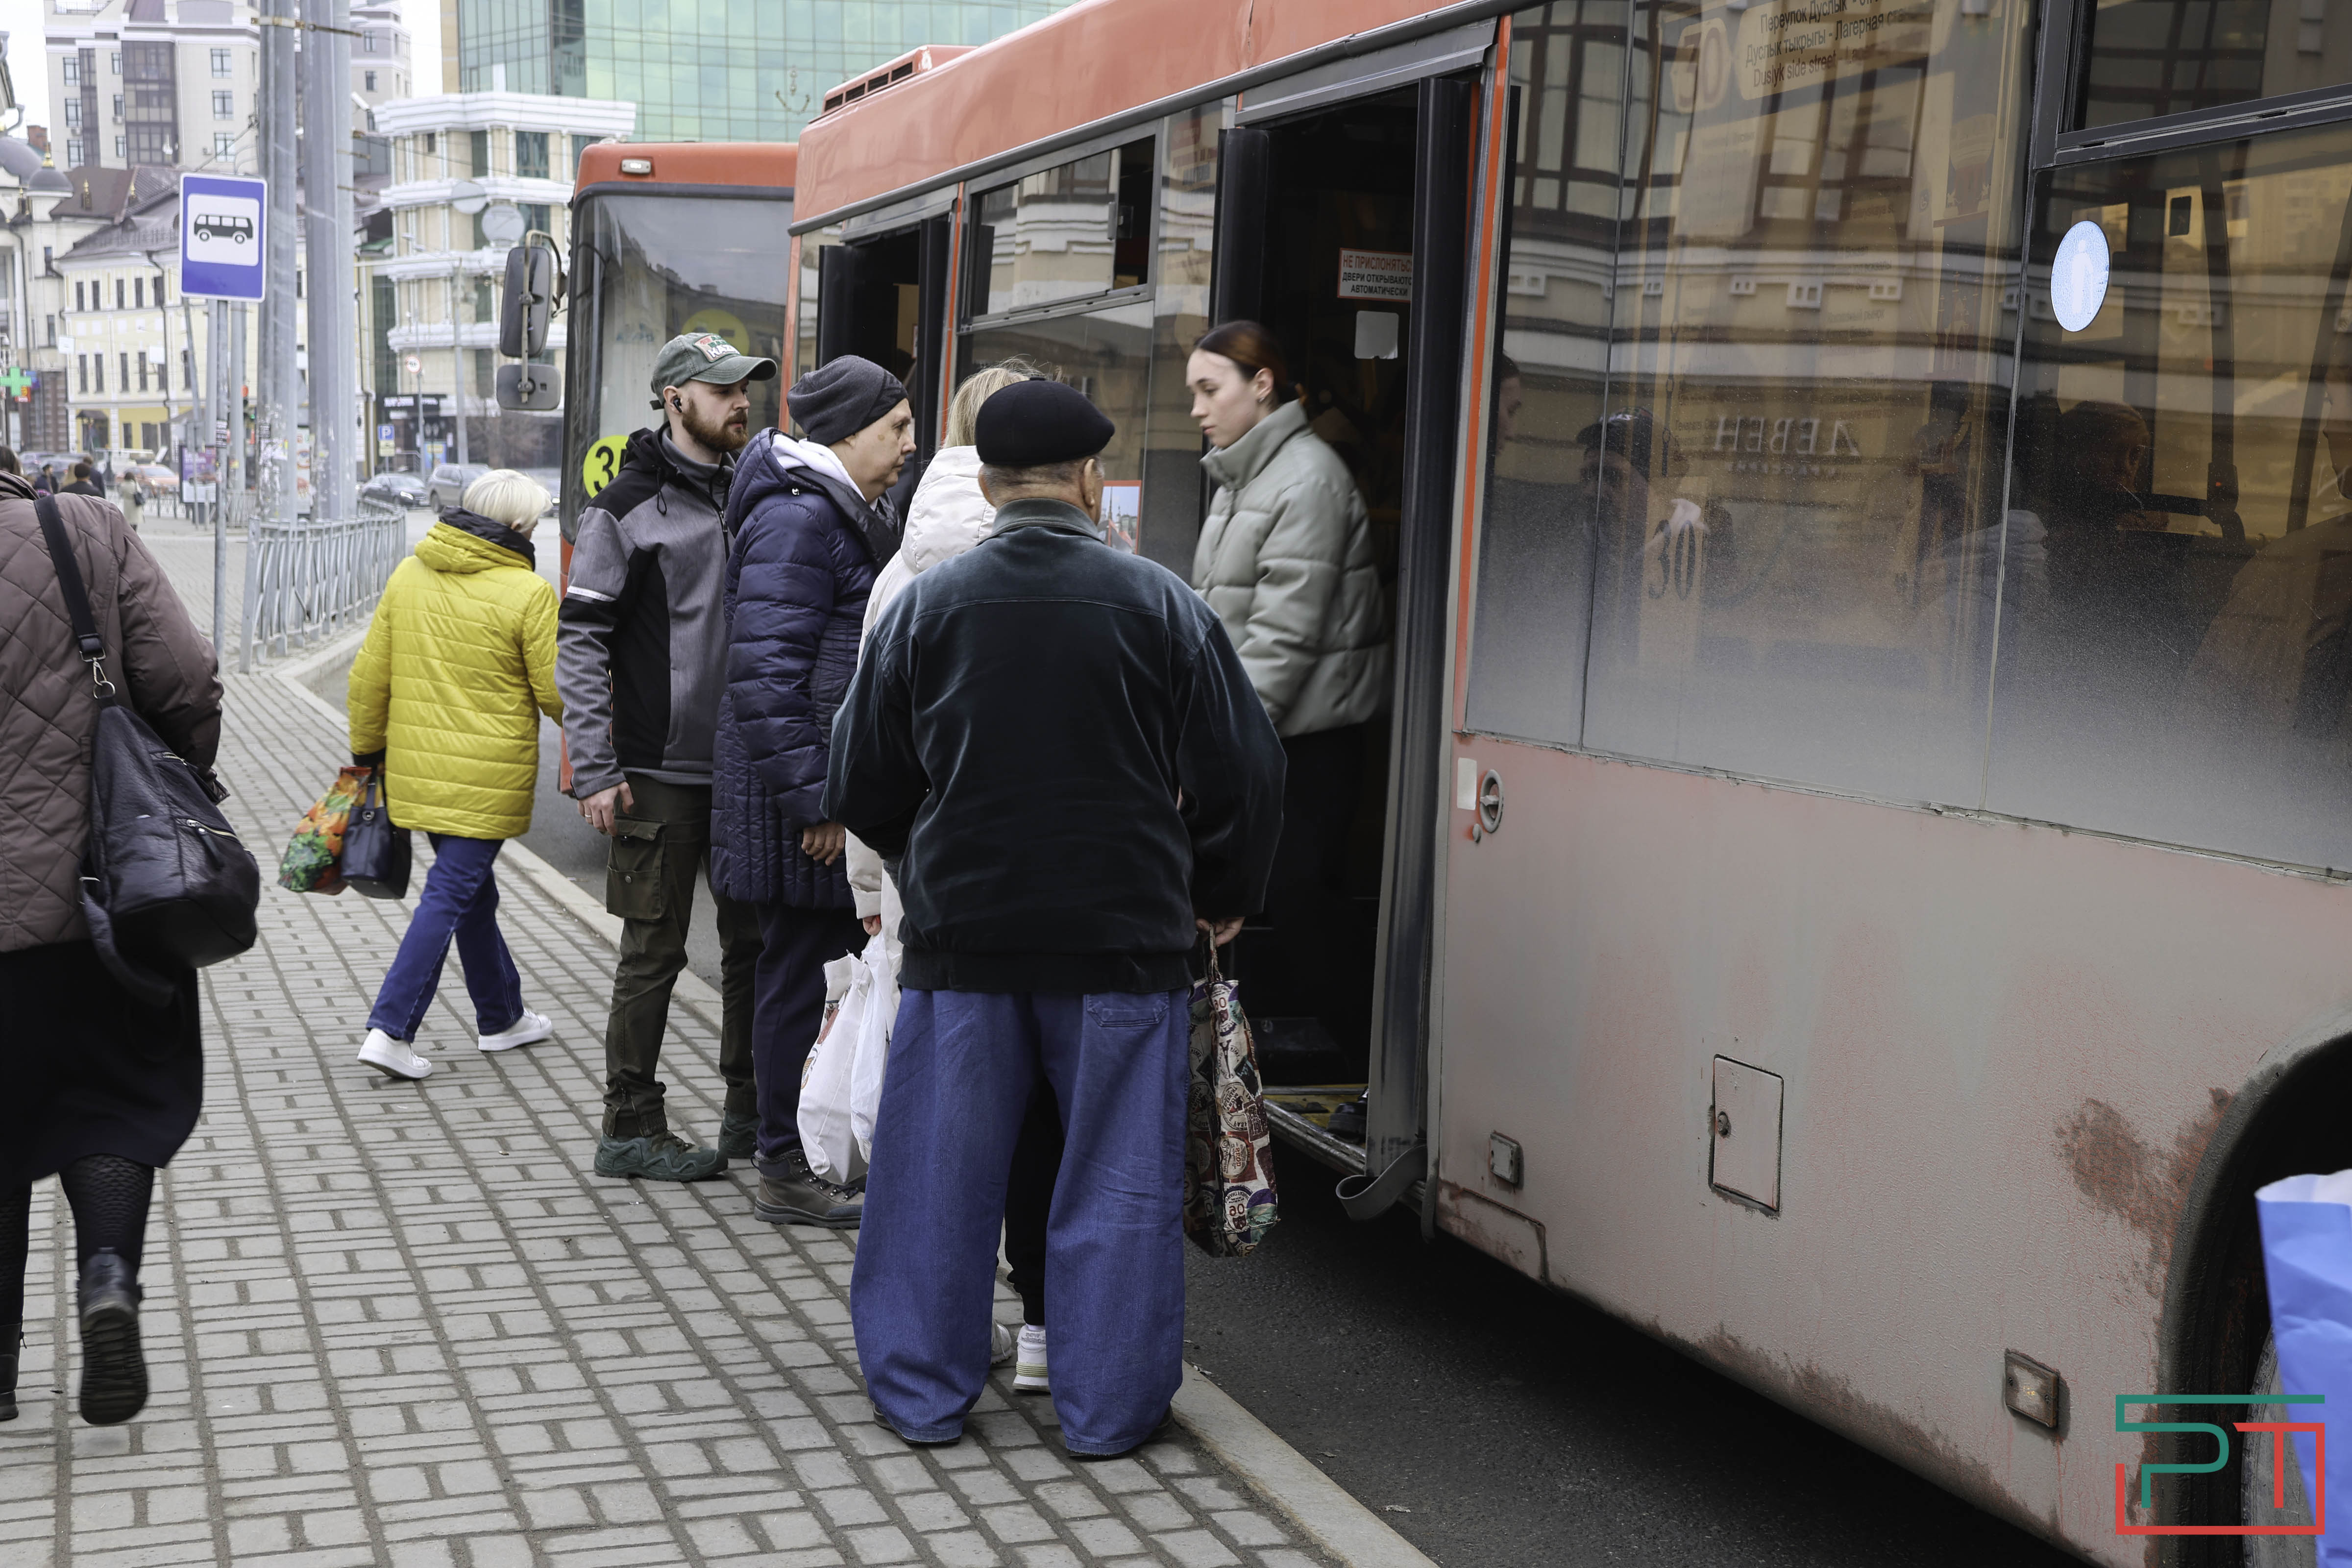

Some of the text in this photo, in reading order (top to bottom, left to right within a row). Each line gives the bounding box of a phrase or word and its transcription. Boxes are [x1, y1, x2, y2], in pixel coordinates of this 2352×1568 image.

[1760, 11, 1807, 34] Переулок
[1809, 0, 1847, 24] Дуслык
[1746, 41, 1781, 68] Дуслык
[1784, 30, 1826, 53] тыкрыгы
[1835, 14, 1884, 41] Лагерная
[1754, 64, 1784, 87] Duslyk
[1787, 58, 1807, 80] side
[1809, 51, 1837, 74] street
[1342, 272, 1365, 282] ДВЕРИ
[1343, 254, 1412, 272] НЕ ПРИСЛОНЯТЬС
[1350, 285, 1408, 296] АВТОМАТИЧЕСКИ
[593, 446, 628, 493] 3
